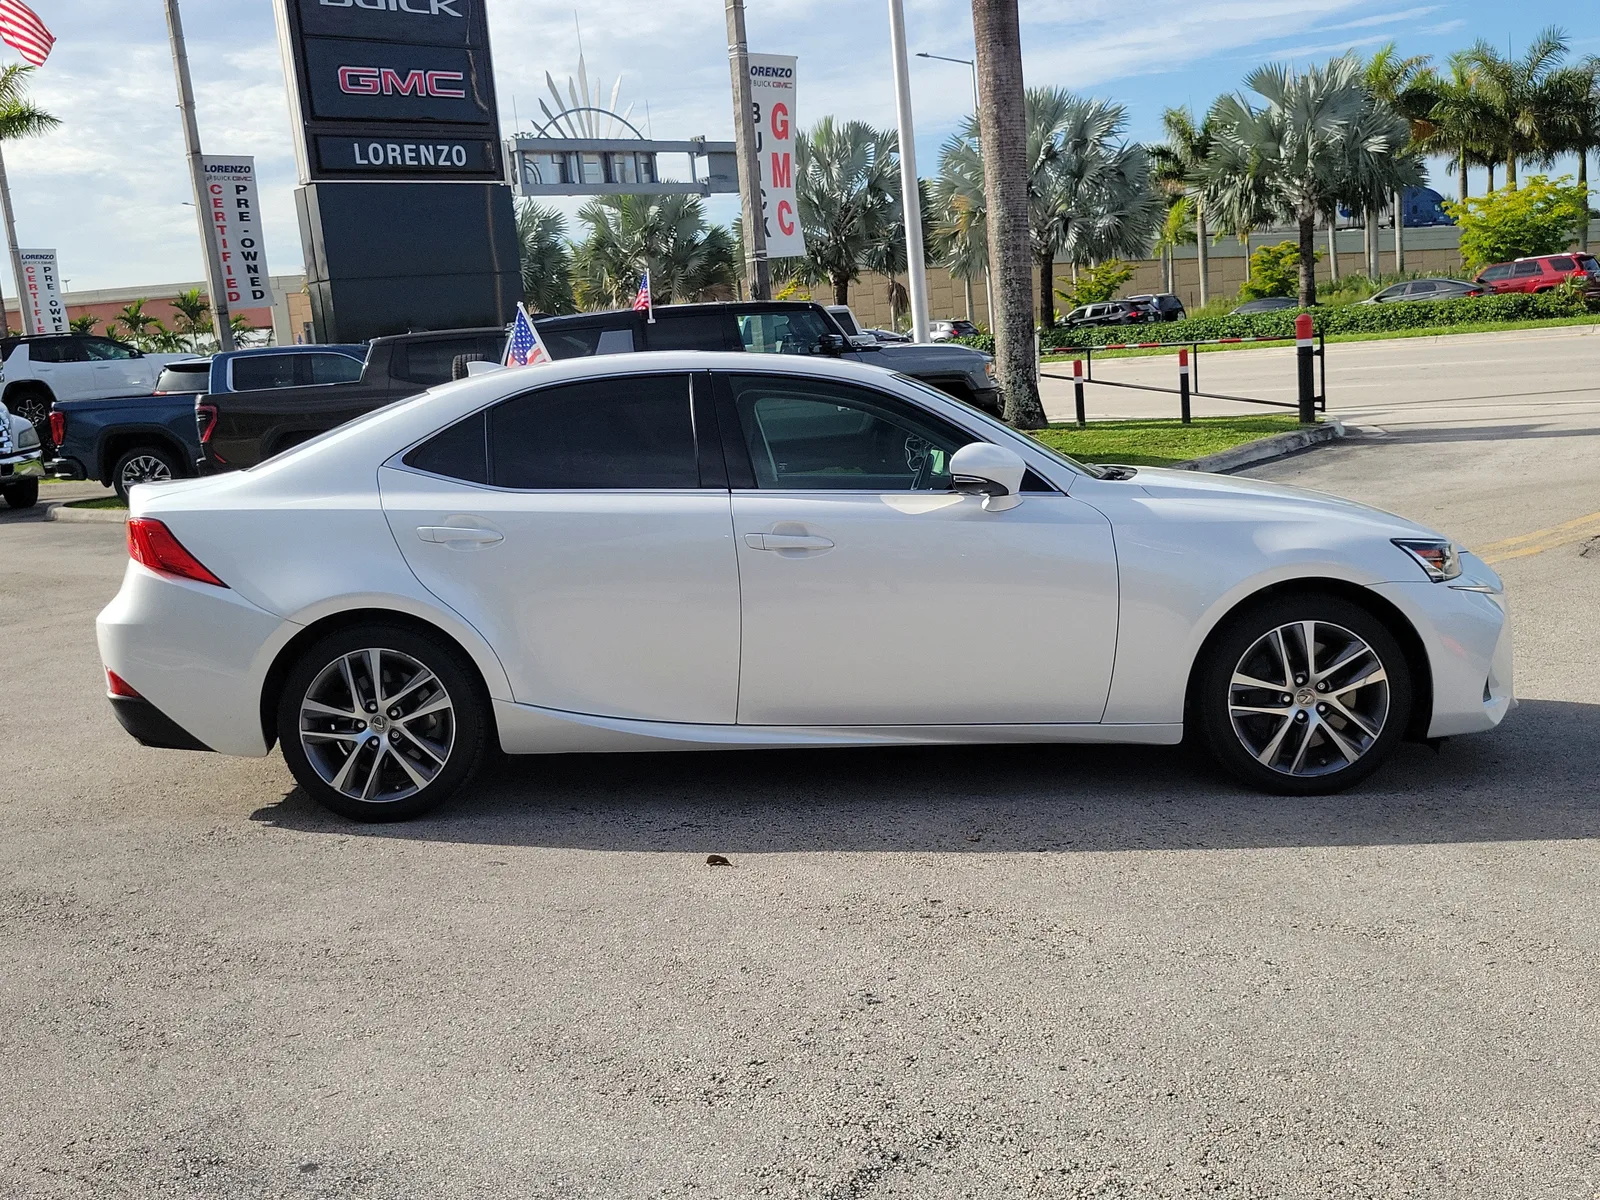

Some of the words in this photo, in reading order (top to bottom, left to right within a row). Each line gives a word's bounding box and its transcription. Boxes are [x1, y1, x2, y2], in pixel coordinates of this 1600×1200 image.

[338, 65, 466, 98] GMC
[750, 65, 793, 78] ORENZO
[753, 79, 771, 88] BUICK
[772, 81, 793, 89] GMC
[204, 164, 252, 174] LORENZO
[353, 143, 467, 167] LORENZO
[771, 102, 795, 236] GMC
[209, 184, 241, 302] CERTIFIED
[235, 184, 265, 300] PRE-OWNED
[25, 266, 46, 333] CERTIFIE
[43, 266, 64, 332] PRE-OWNE
